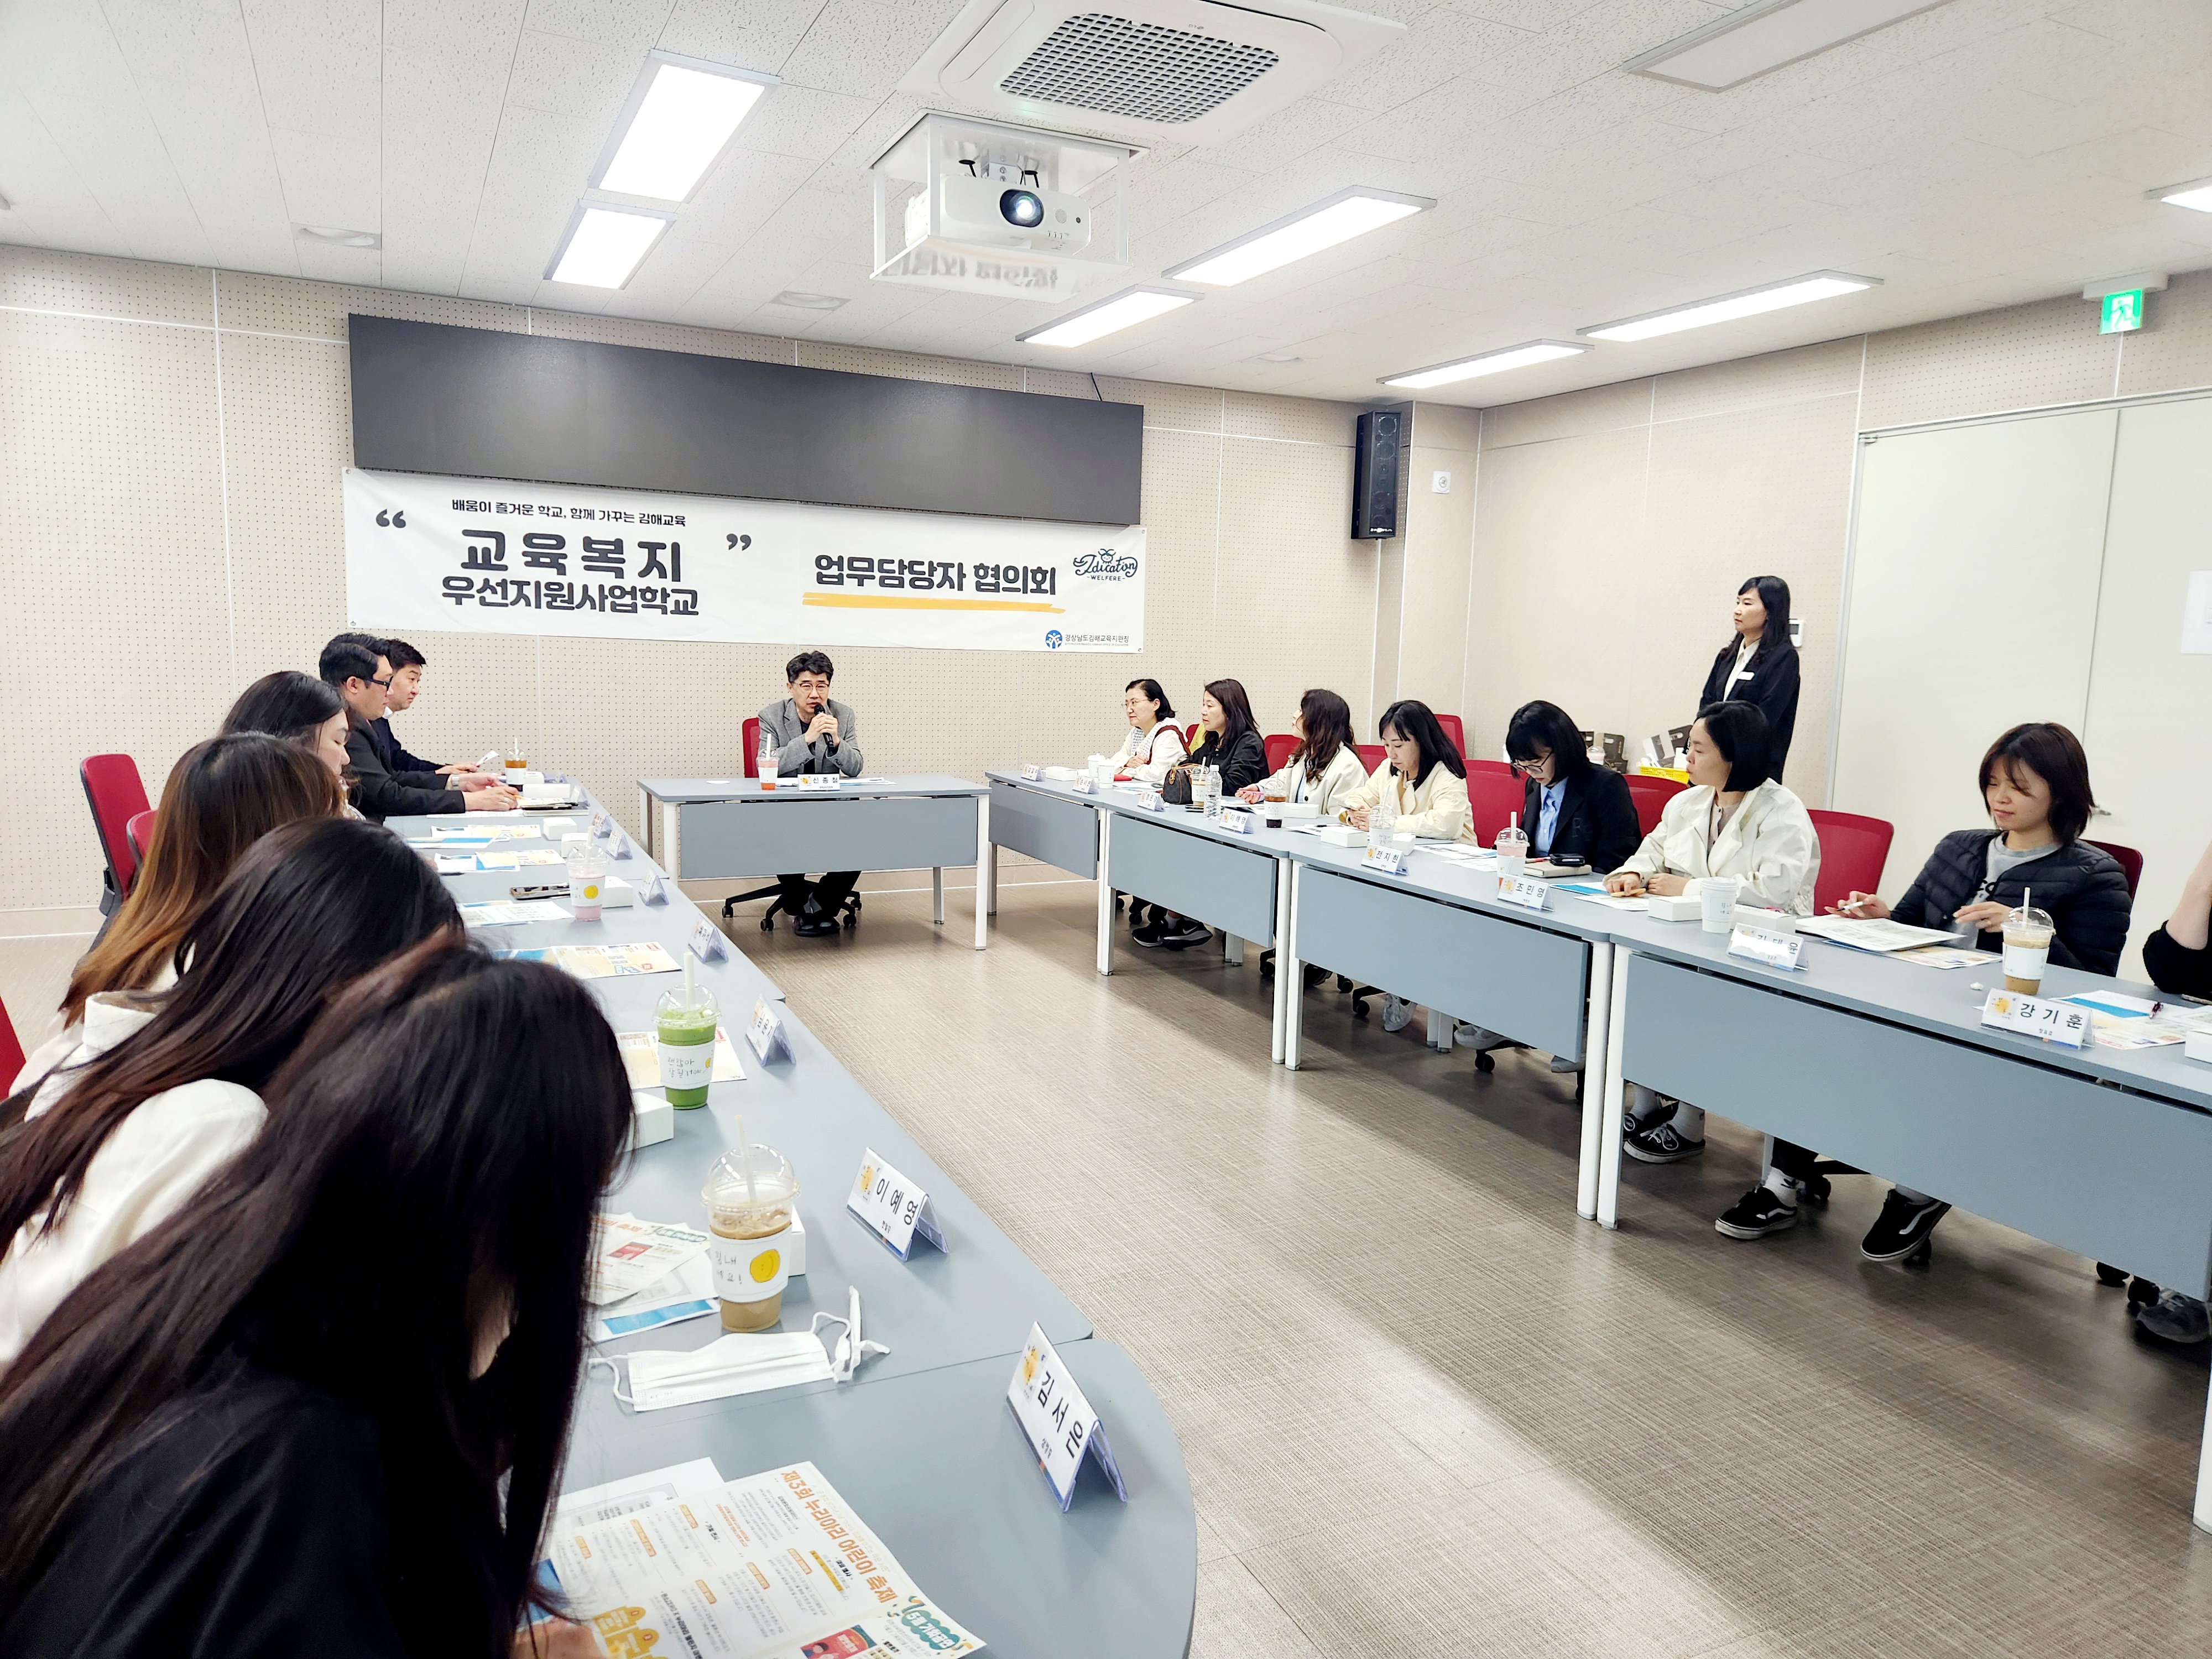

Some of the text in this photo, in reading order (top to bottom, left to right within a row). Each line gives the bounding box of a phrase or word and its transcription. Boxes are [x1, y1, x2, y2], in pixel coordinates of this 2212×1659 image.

[452, 499, 686, 527] 배움이 즐거운 학교, 함께 가꾸는 김해교육
[461, 529, 681, 582] 교육복지
[815, 554, 1056, 595] 업무담당자 협의회
[442, 575, 699, 615] 우선지원사업학교
[781, 1470, 815, 1500] 제3회
[805, 1500, 849, 1540] 누리아리
[838, 1540, 877, 1575] 어린이
[867, 1575, 899, 1603] 축제
